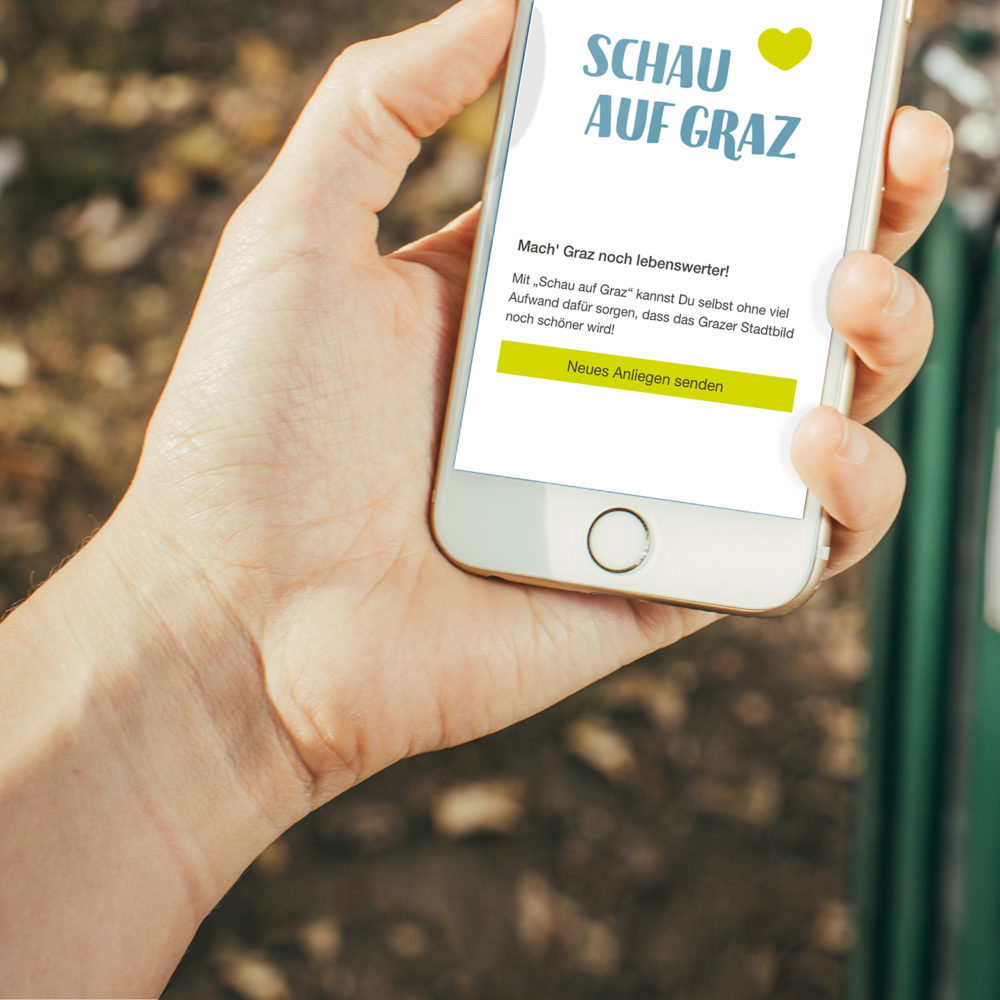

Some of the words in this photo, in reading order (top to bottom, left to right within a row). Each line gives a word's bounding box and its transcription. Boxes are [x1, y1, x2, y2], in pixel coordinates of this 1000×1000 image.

[582, 33, 732, 93] SCHAU
[583, 94, 676, 144] AUF
[680, 104, 802, 161] GRAZ
[517, 239, 560, 256] Mach'
[563, 245, 596, 261] Graz
[598, 252, 633, 265] noch
[636, 254, 730, 278] lebenswerter!
[508, 291, 560, 308] Aufwand
[562, 299, 594, 312] dafür
[595, 305, 639, 321] sorgen,
[642, 309, 670, 323] dass
[673, 313, 695, 326] das
[698, 316, 738, 331] Grazer
[740, 321, 795, 339] Stadtbild
[512, 272, 530, 285] Mit
[578, 282, 598, 293] auf
[636, 288, 675, 304] kannst
[678, 293, 695, 306] Du
[698, 298, 734, 312] selbst
[736, 302, 766, 316] ohne
[769, 308, 790, 318] viel
[505, 313, 534, 324] noch
[537, 316, 584, 331] schöner
[587, 323, 615, 335] wird!
[567, 359, 609, 378] Neues
[612, 366, 671, 387] Anliegen
[674, 377, 724, 393] senden
